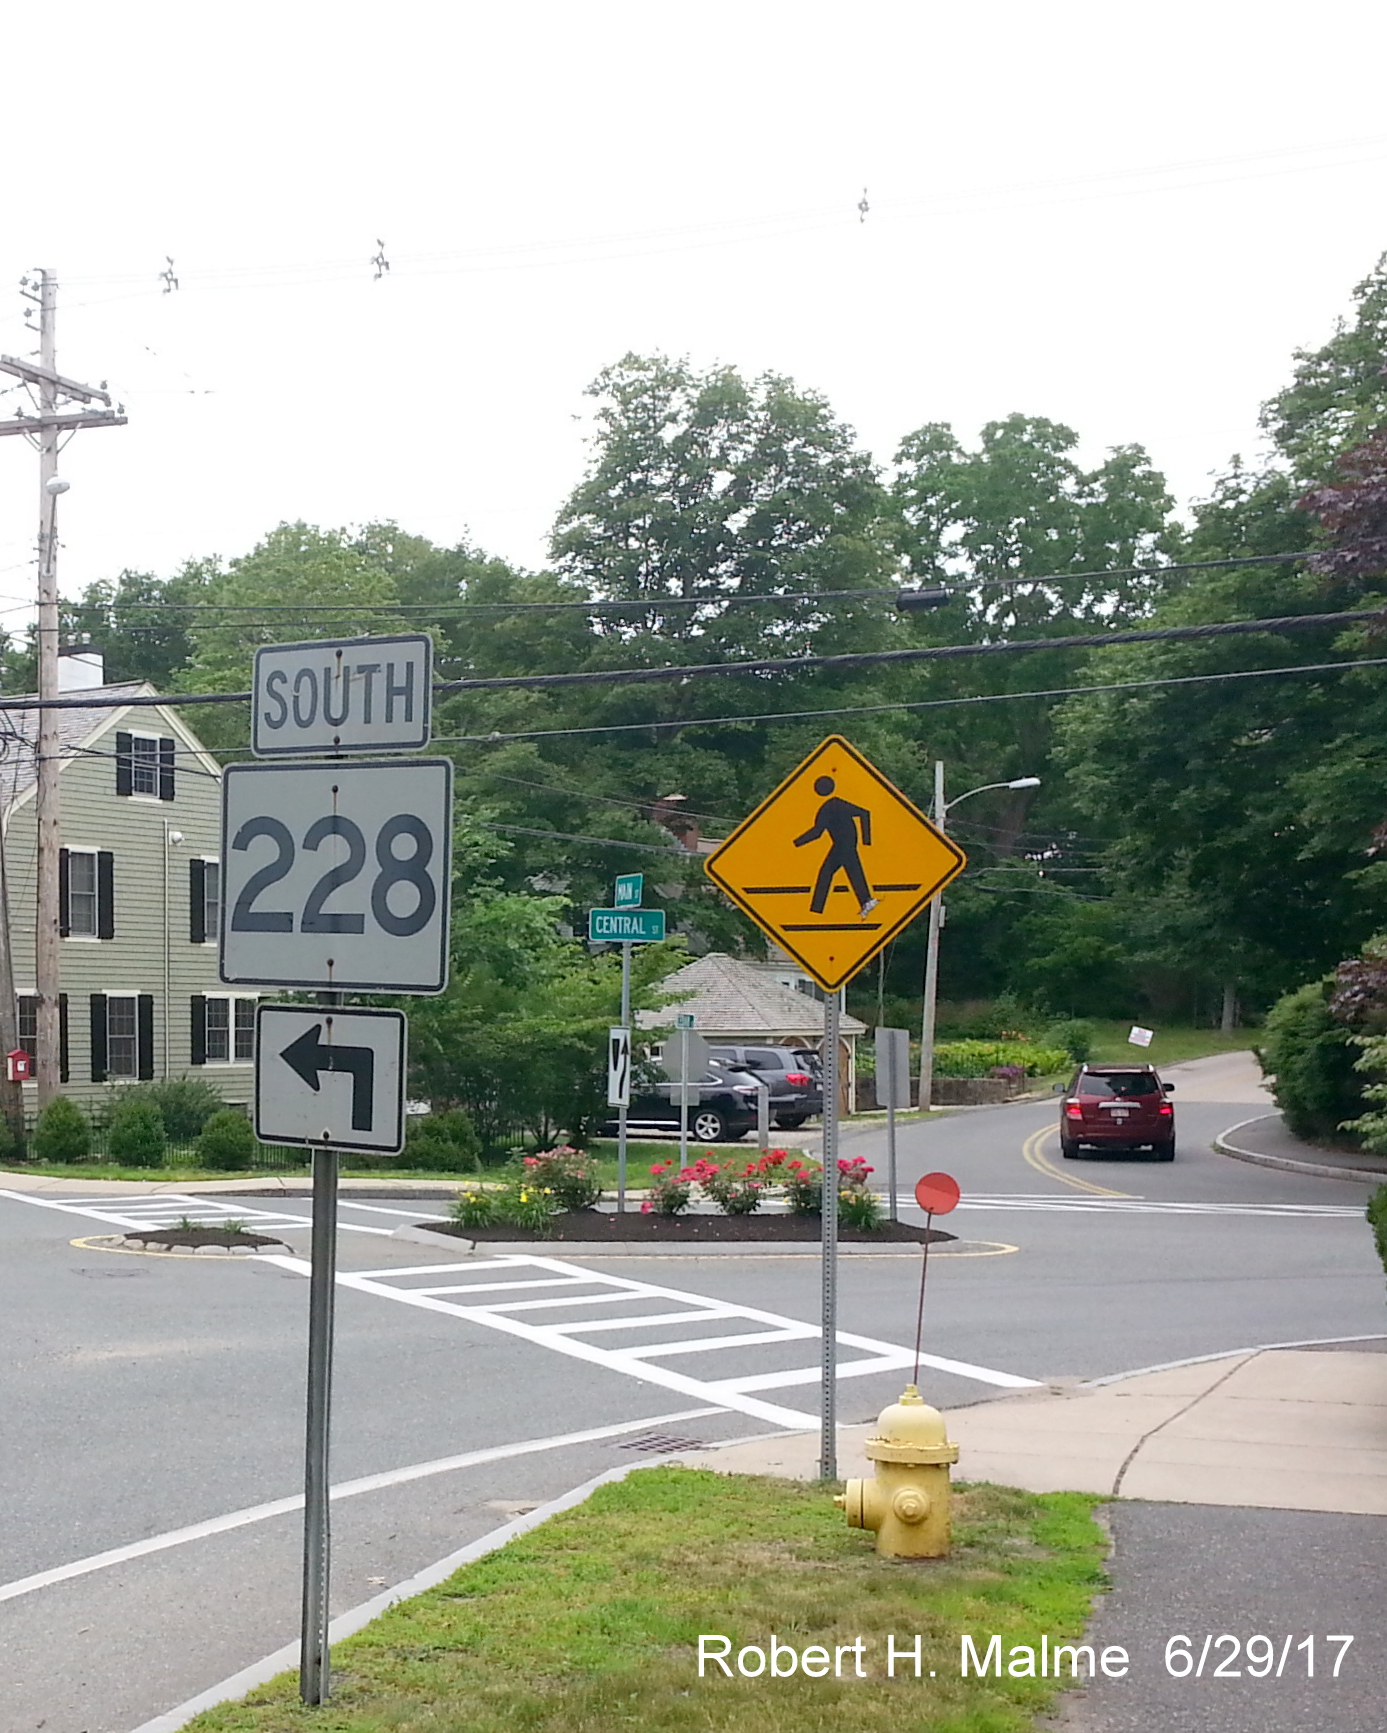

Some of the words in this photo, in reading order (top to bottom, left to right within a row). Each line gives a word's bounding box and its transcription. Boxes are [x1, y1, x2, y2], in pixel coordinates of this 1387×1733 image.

[264, 661, 414, 729] SOUTH
[230, 813, 436, 937] 228
[618, 882, 633, 900] MAIN
[595, 916, 646, 934] CENTRAL
